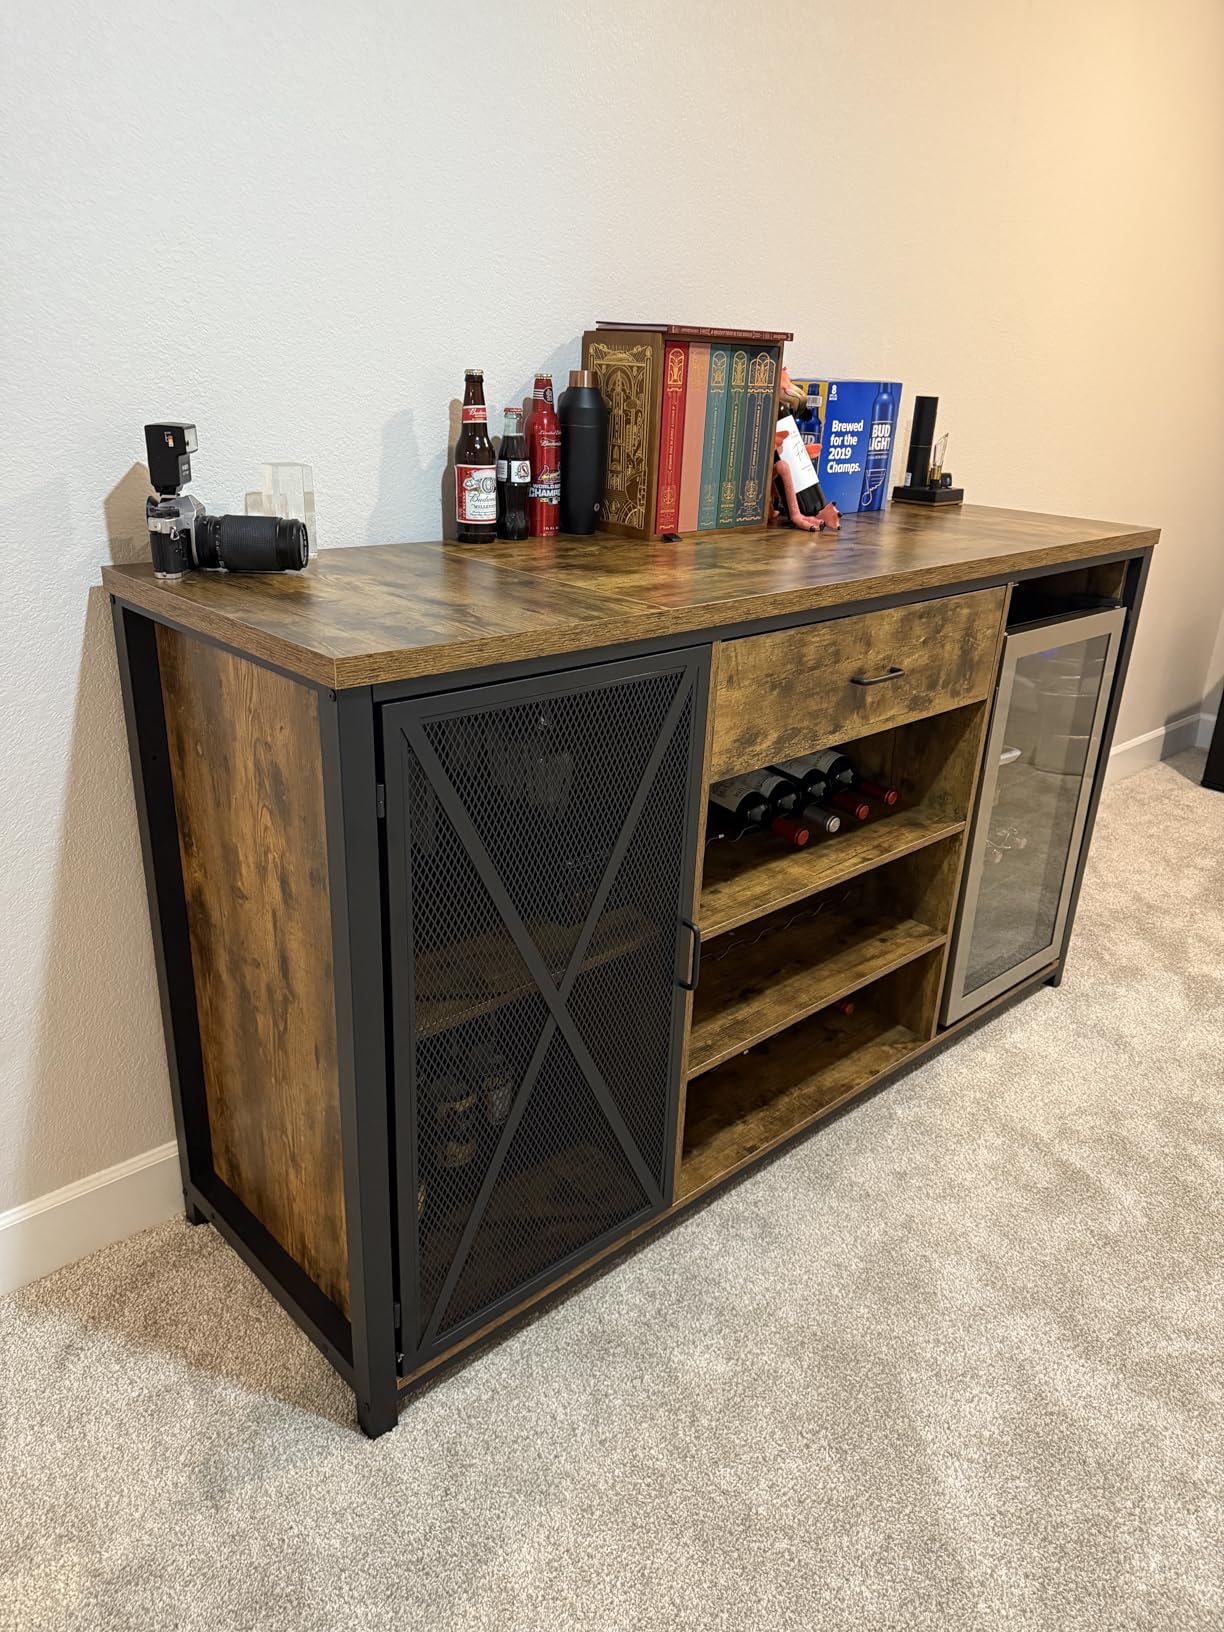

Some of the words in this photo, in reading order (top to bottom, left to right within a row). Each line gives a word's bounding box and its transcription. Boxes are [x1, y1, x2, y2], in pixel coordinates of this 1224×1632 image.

[831, 384, 837, 394] 8
[831, 420, 864, 432] Brewed
[872, 424, 891, 437] BUD
[830, 434, 842, 446] for
[844, 434, 858, 446] the
[868, 437, 891, 451] LIGHT
[828, 447, 852, 460] 2019
[827, 461, 861, 474] Champs.
